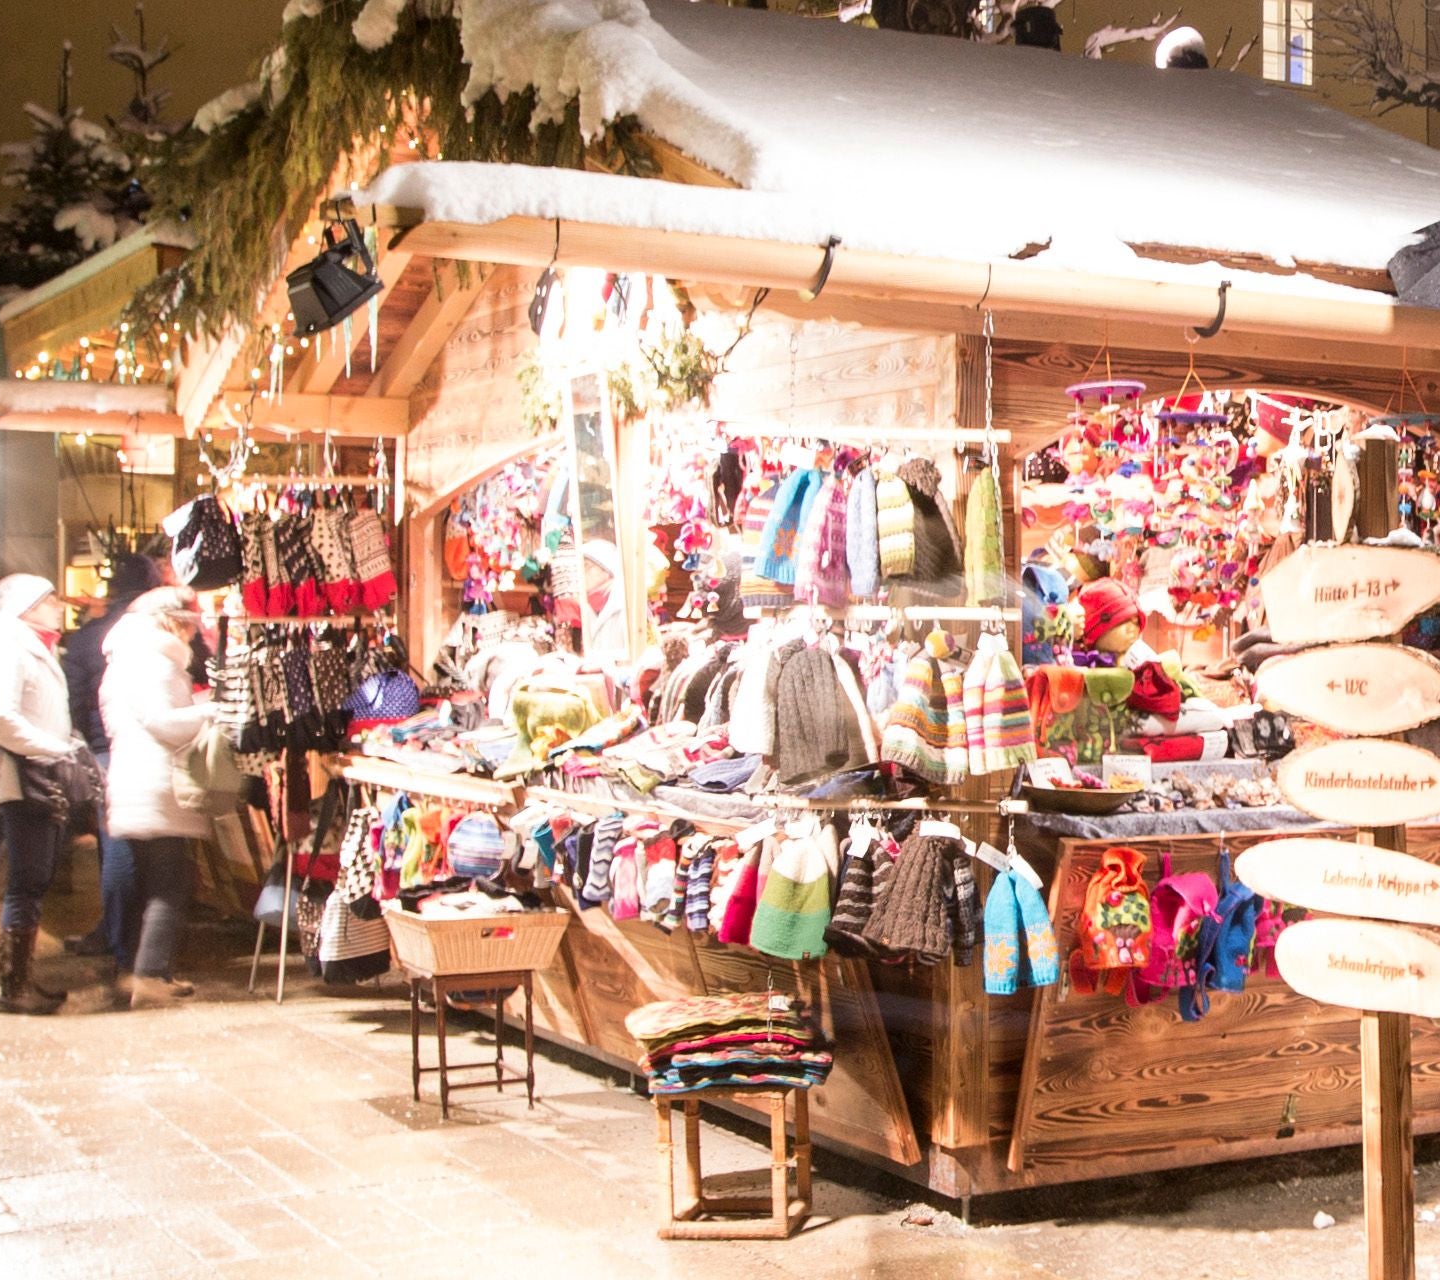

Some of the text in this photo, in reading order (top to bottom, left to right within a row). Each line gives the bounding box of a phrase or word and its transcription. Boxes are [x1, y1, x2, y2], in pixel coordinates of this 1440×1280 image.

[1314, 581, 1381, 603] Hütte 1-13
[1345, 679, 1368, 696] WC
[1304, 771, 1418, 791] Kinderbastelstube
[1322, 870, 1420, 896] Lebende Krippe
